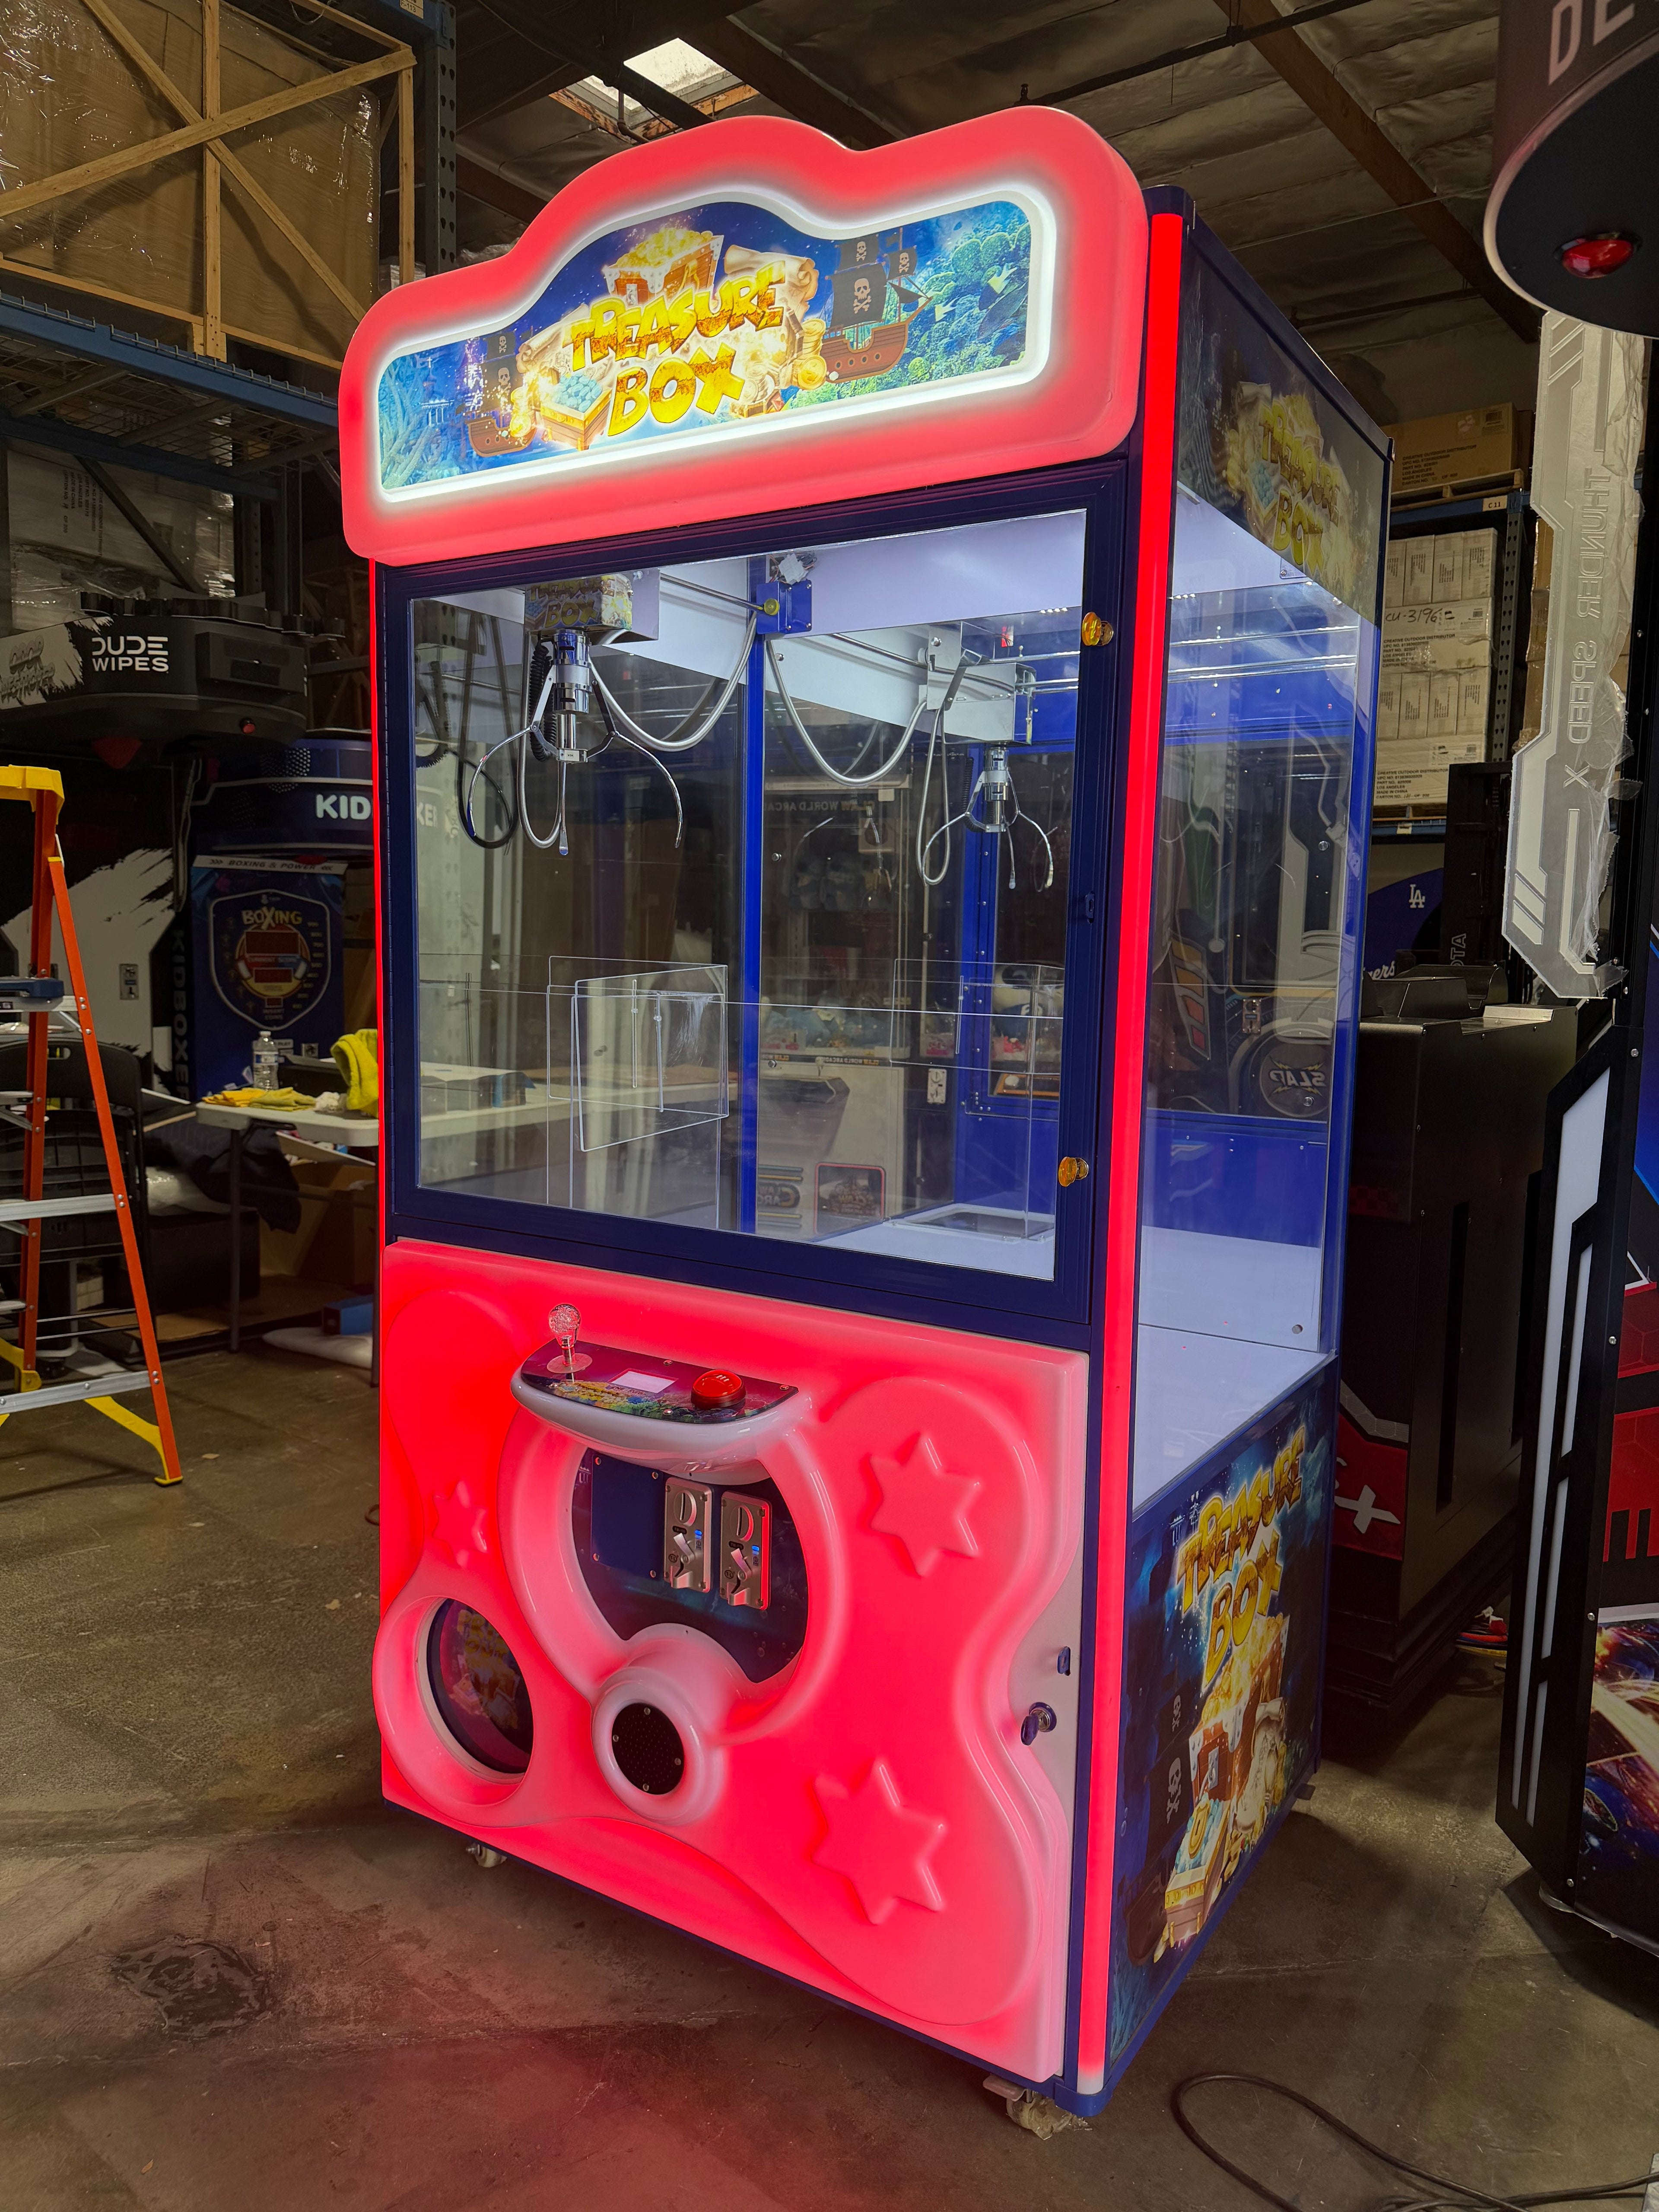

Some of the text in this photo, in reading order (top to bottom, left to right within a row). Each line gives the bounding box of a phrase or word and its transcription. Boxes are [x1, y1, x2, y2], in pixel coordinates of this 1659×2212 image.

[401, 3, 416, 13] F-113
[563, 261, 786, 371] TREASURE
[607, 343, 745, 436] BOX
[1258, 398, 1339, 528] TREASURE
[1273, 488, 1325, 577] BOX
[544, 597, 598, 628] BOX
[92, 636, 169, 656] DUDE
[92, 657, 169, 673] WIPES
[229, 859, 265, 868] BOXING
[1409, 884, 1425, 908] LA
[241, 906, 302, 931] BOXING
[1176, 1425, 1306, 1613] TREASURE
[1202, 1528, 1282, 1688] BOX
